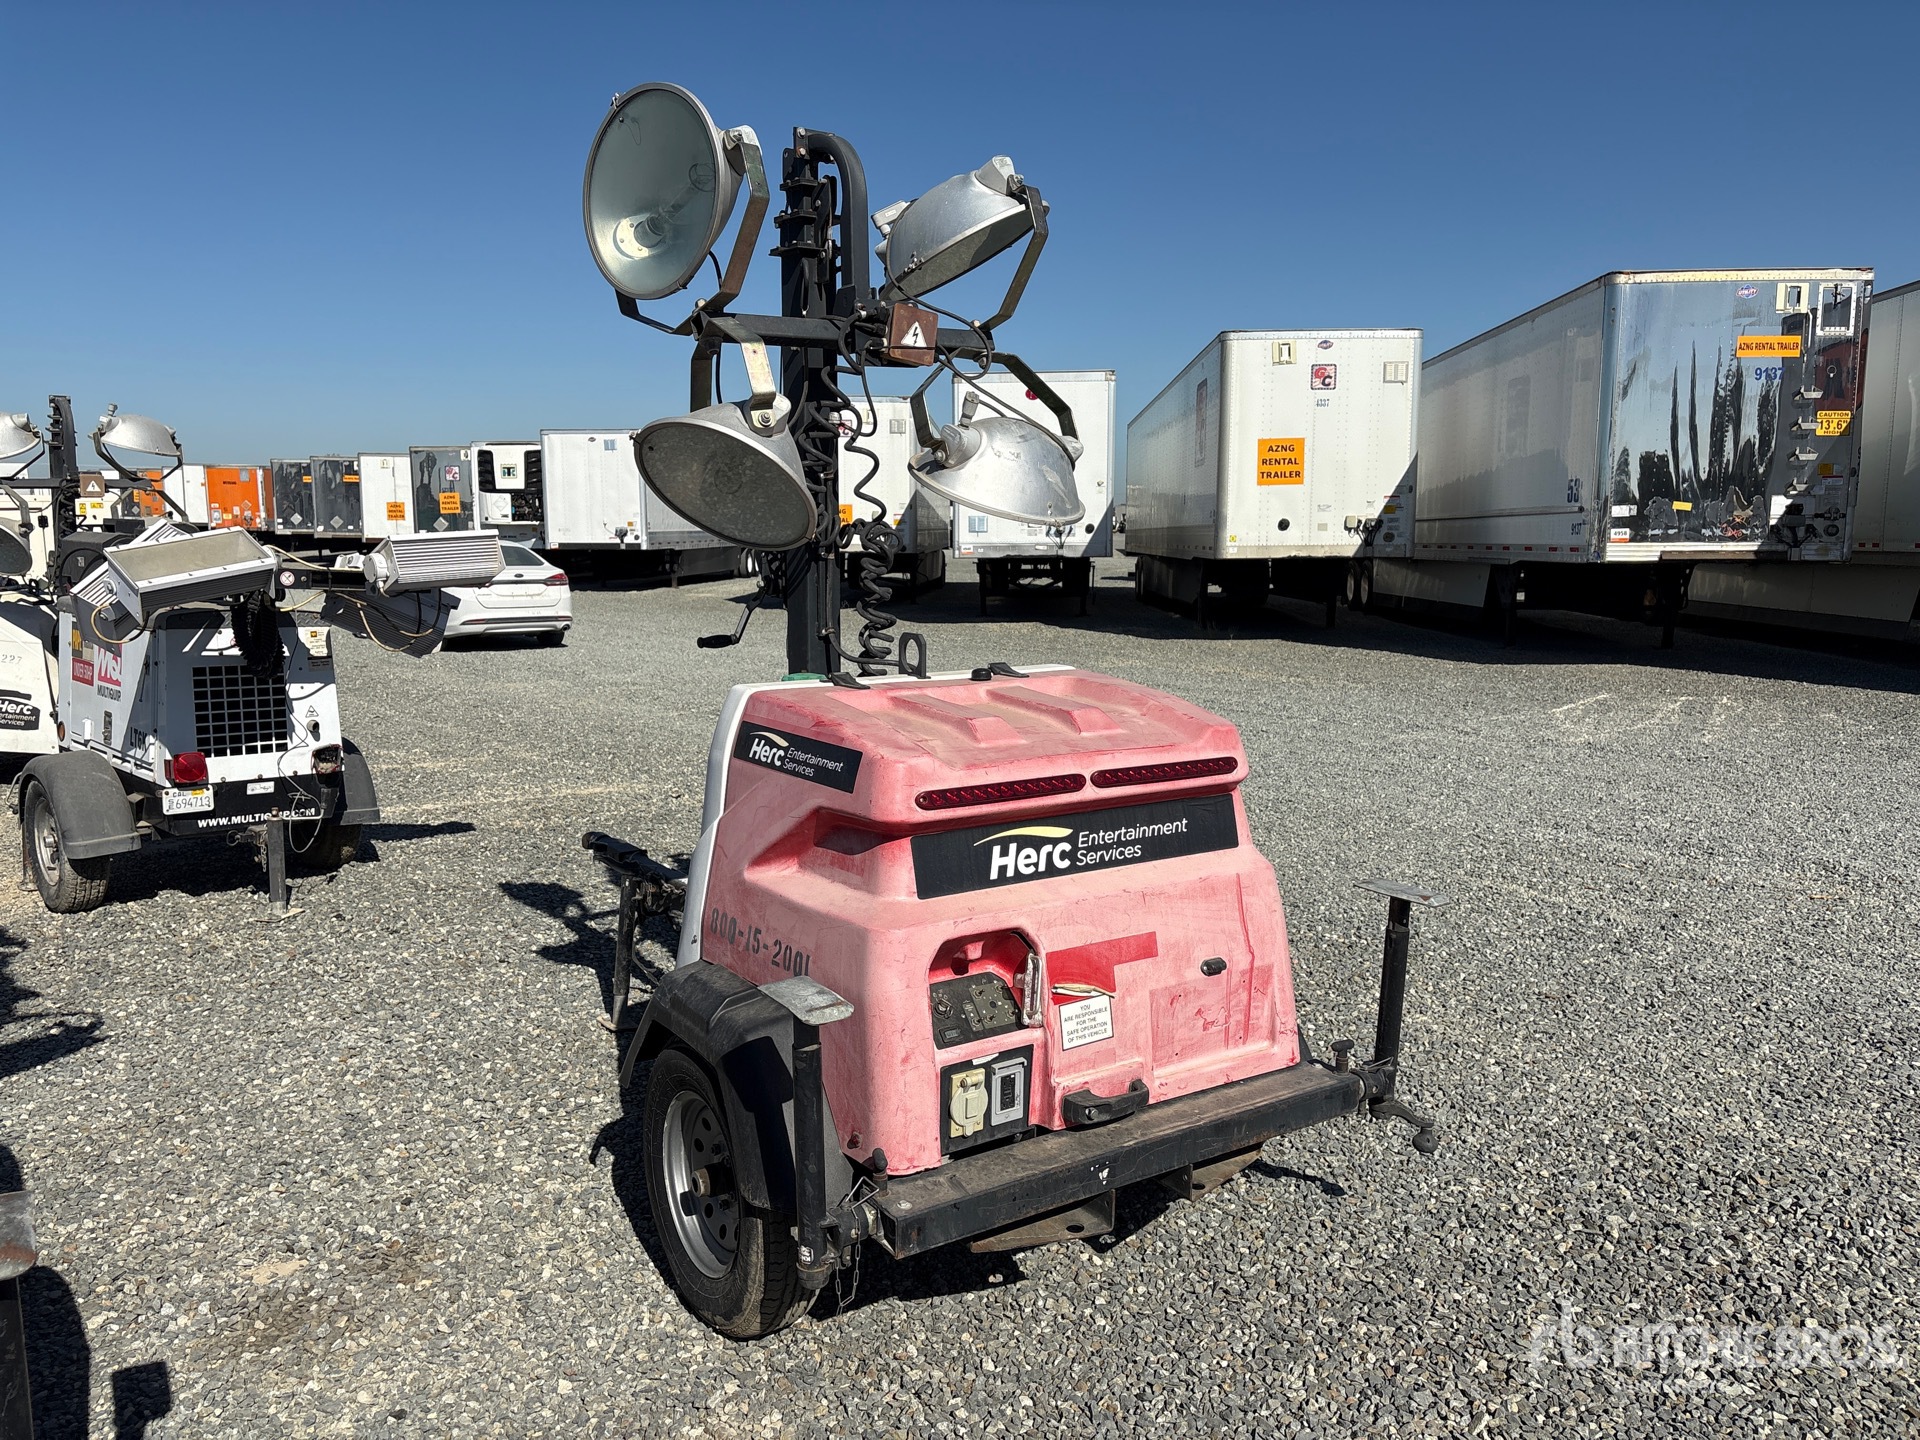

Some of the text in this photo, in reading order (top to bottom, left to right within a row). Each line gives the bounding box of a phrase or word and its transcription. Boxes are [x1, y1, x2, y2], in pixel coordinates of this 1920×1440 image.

[1738, 342, 1800, 351] AZNG RENTAL TRAILER
[1755, 366, 1786, 381] 9137
[1267, 444, 1295, 453] AZNG
[1261, 457, 1300, 466] RENTAL
[1260, 470, 1301, 479] TRAILER
[749, 738, 785, 767] Herc
[787, 747, 844, 772] Entertainment
[783, 758, 815, 777] Services
[1078, 817, 1188, 848] Entertainment
[990, 842, 1073, 880] Herc
[1076, 843, 1142, 866] Services
[1064, 1006, 1108, 1023] ARE RESPONSIBLE
[1080, 1004, 1091, 1012] YOU
[1087, 1016, 1097, 1024] THE
[1067, 1021, 1108, 1036] SAFE OPERATION
[1076, 1033, 1087, 1041] THIS
[1087, 1028, 1108, 1038] VEHICLE
